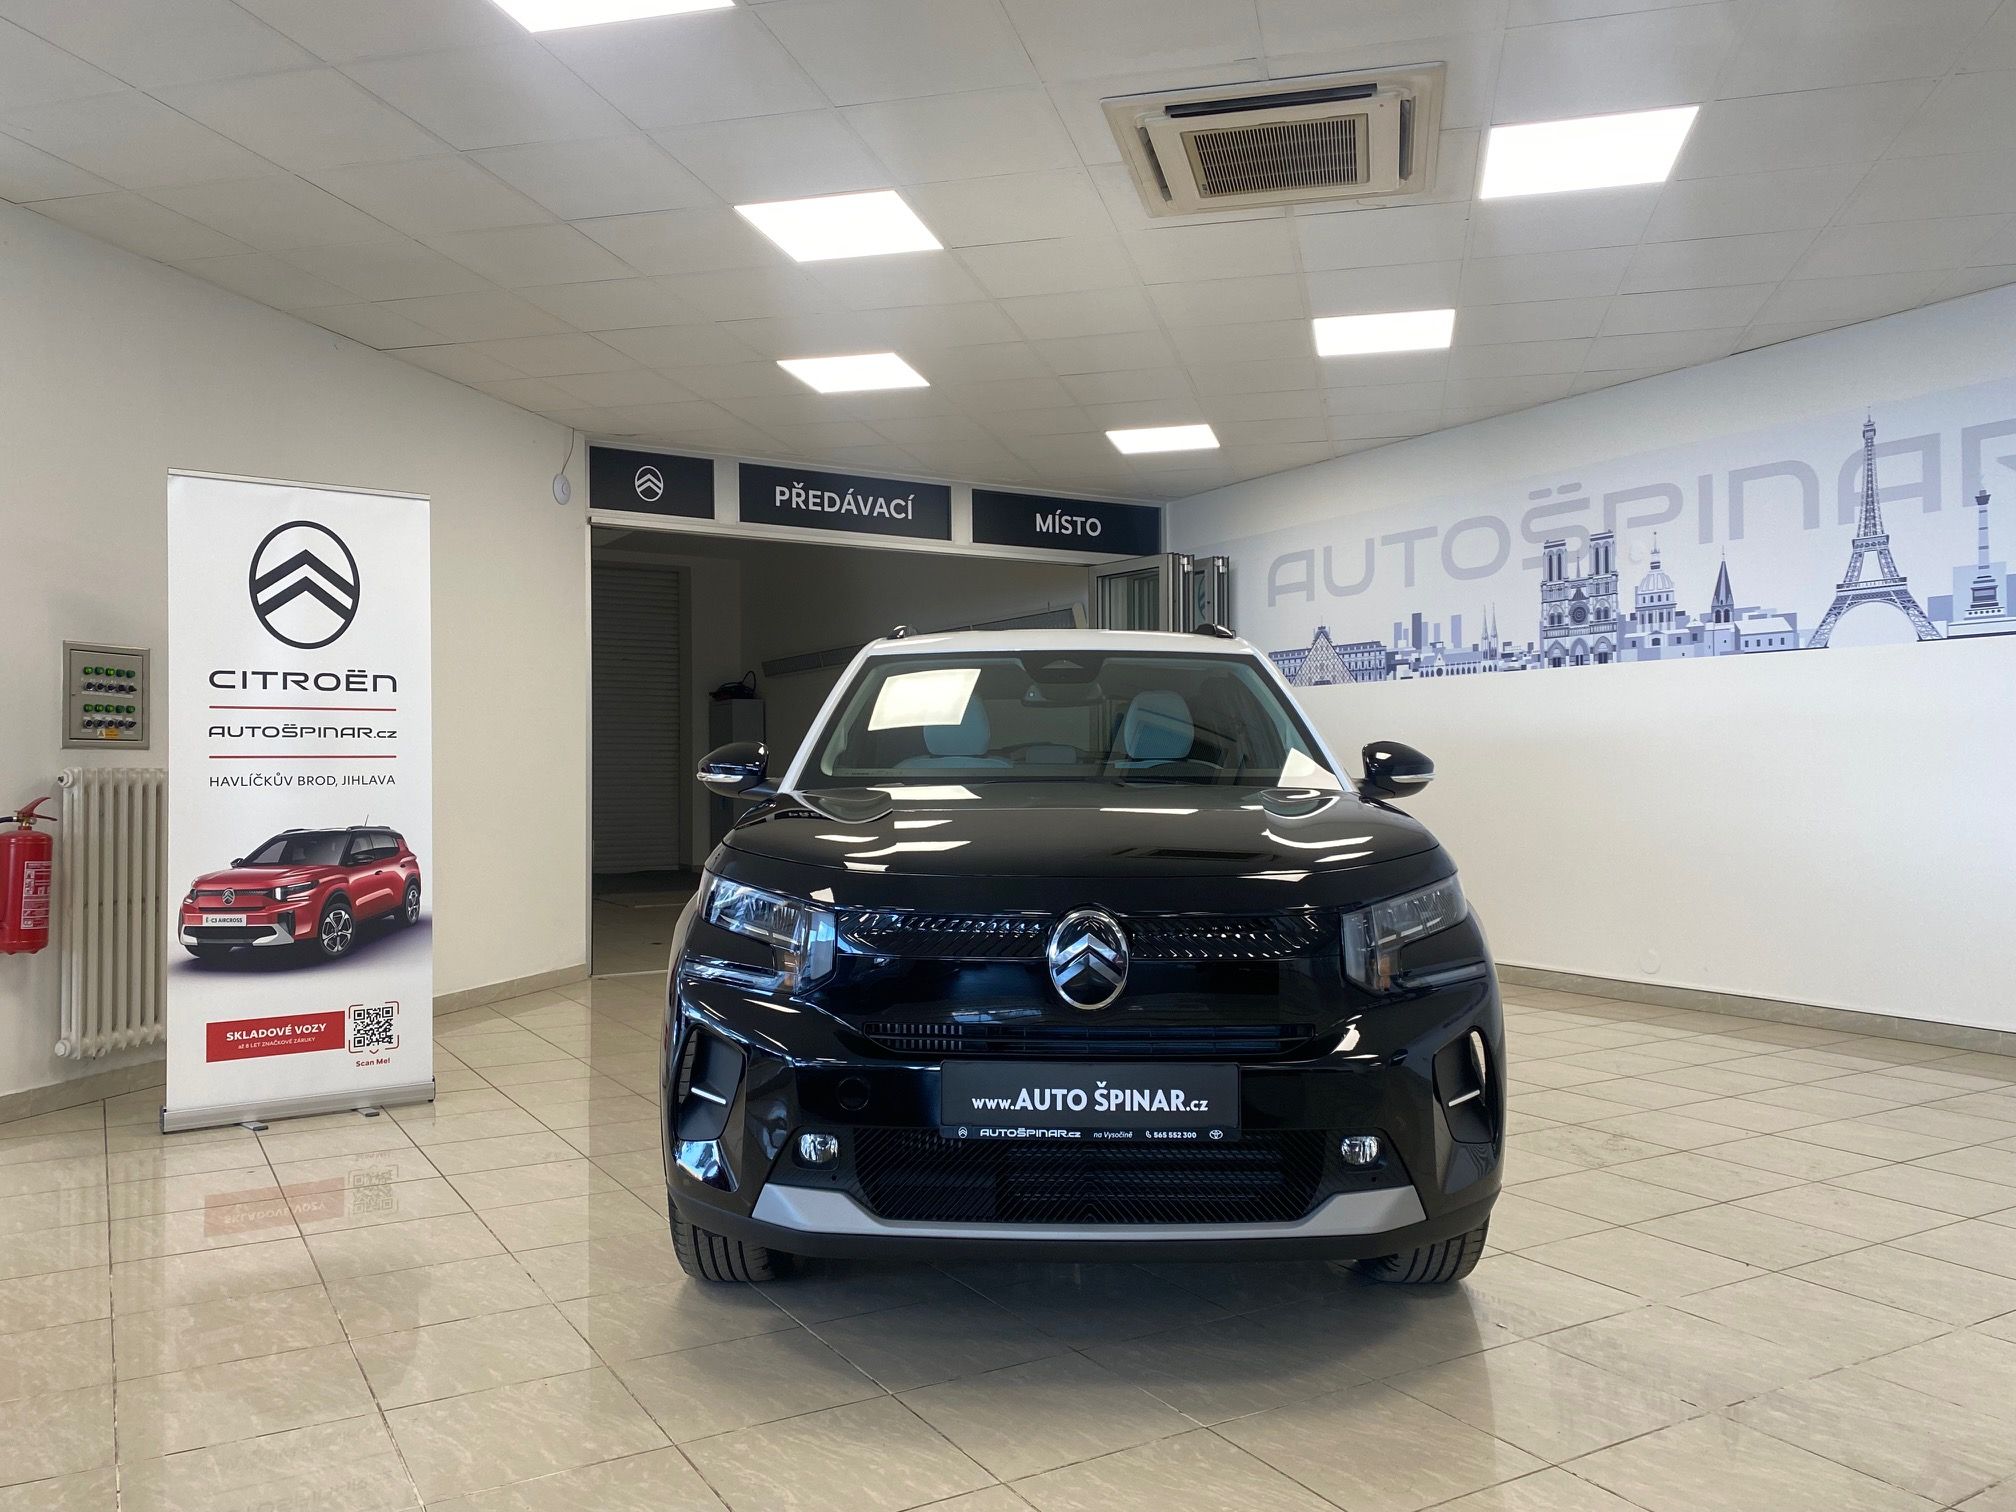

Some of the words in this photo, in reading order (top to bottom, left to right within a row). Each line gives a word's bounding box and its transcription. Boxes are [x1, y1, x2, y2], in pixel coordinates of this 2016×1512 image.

[774, 482, 915, 520] PŘEDÁVACÍ
[1035, 509, 1102, 537] MÍSTO
[208, 669, 397, 693] CITROËN
[209, 772, 293, 787] HAVLÍČKŮV
[297, 775, 338, 787] BROD,
[341, 774, 396, 786] JIHLAVA
[226, 1024, 292, 1041] SKLADOVÉ
[294, 1023, 327, 1034] VOZY
[261, 1038, 293, 1047] ZNAČKOVÉ
[293, 1036, 316, 1044] ZÁRUKY
[355, 1058, 375, 1068] Scan
[376, 1057, 391, 1066] Me!
[971, 1088, 1088, 1112] www.AUTO
[1094, 1081, 1209, 1112] ŠPINAR.cz
[1103, 1131, 1133, 1140] Vysočině
[1153, 1131, 1168, 1139] 565
[1168, 1131, 1182, 1139] 552
[1183, 1131, 1197, 1139] 300
